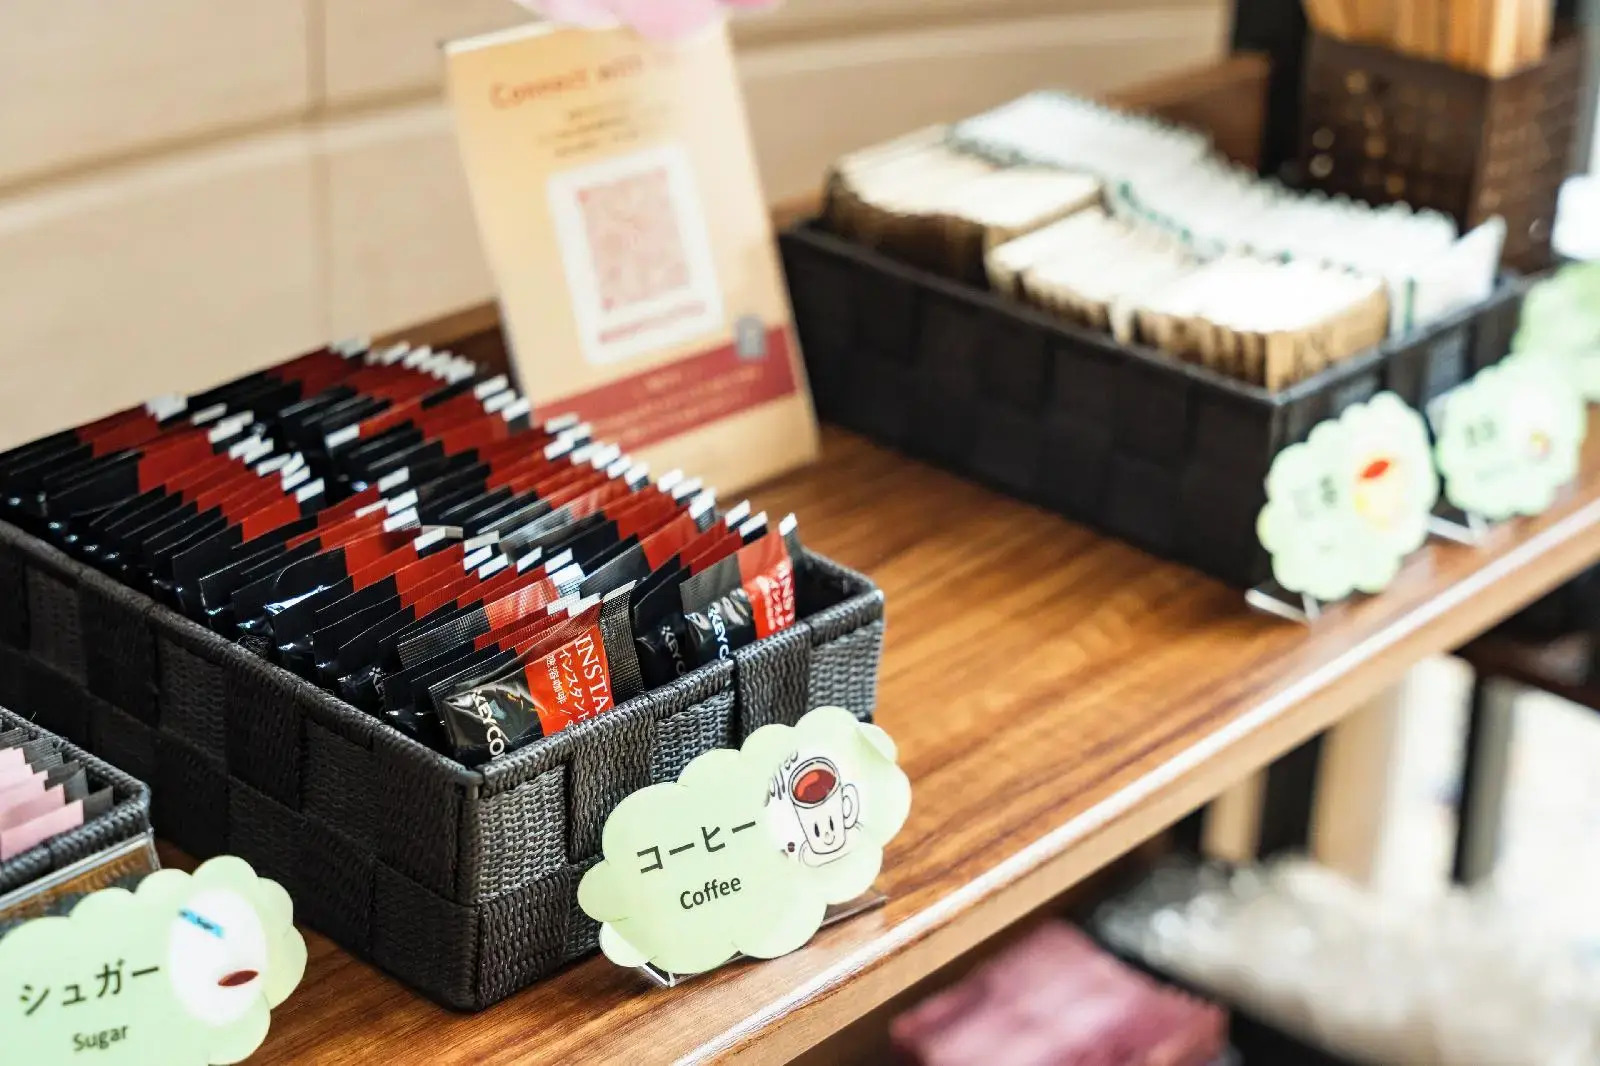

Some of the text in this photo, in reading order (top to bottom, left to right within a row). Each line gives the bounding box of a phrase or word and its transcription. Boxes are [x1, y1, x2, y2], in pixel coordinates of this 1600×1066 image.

[486, 726, 507, 761] CO
[636, 820, 757, 874] コーヒー
[679, 876, 743, 910] Coffee
[18, 957, 160, 1017] シュガー
[72, 1024, 129, 1052] Sugar
